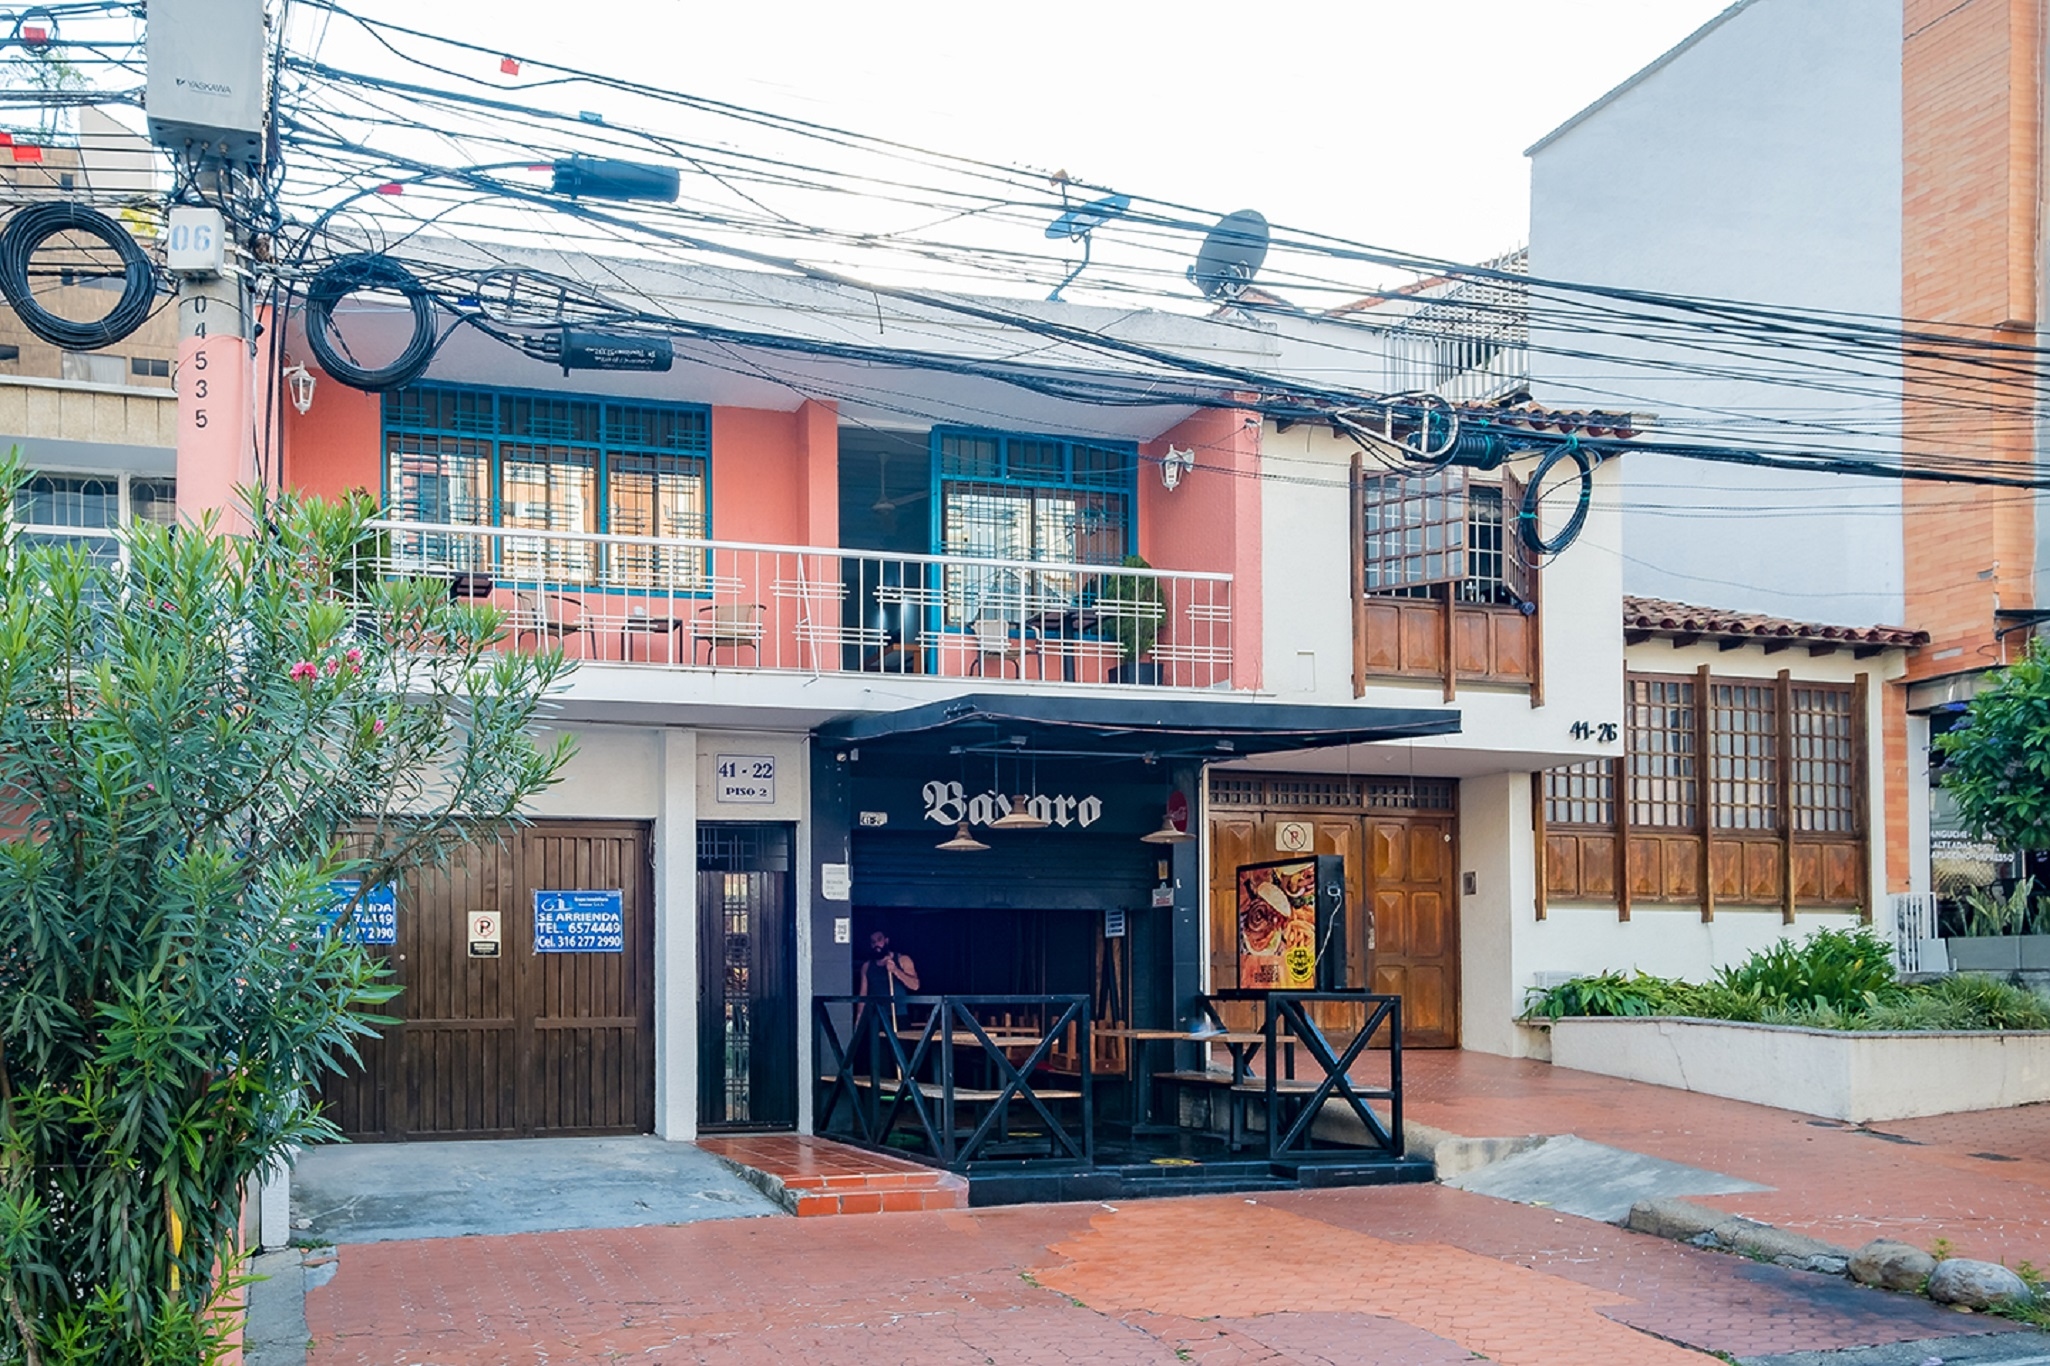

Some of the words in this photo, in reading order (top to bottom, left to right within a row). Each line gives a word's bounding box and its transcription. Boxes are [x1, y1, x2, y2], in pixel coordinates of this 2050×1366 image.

[187, 80, 232, 94] YASKAWA
[171, 224, 212, 251] 06
[718, 761, 736, 778] 41
[752, 762, 773, 779] 22
[725, 787, 756, 796] PISO
[759, 787, 767, 797] 2
[538, 913, 553, 922] SE
[556, 913, 619, 922] ARRIENDA
[537, 922, 564, 934] TEL.
[568, 922, 621, 934] 6574449
[538, 935, 556, 948] Cel.
[557, 935, 576, 948] 316
[577, 935, 595, 947] 277
[597, 935, 621, 947] 2990
